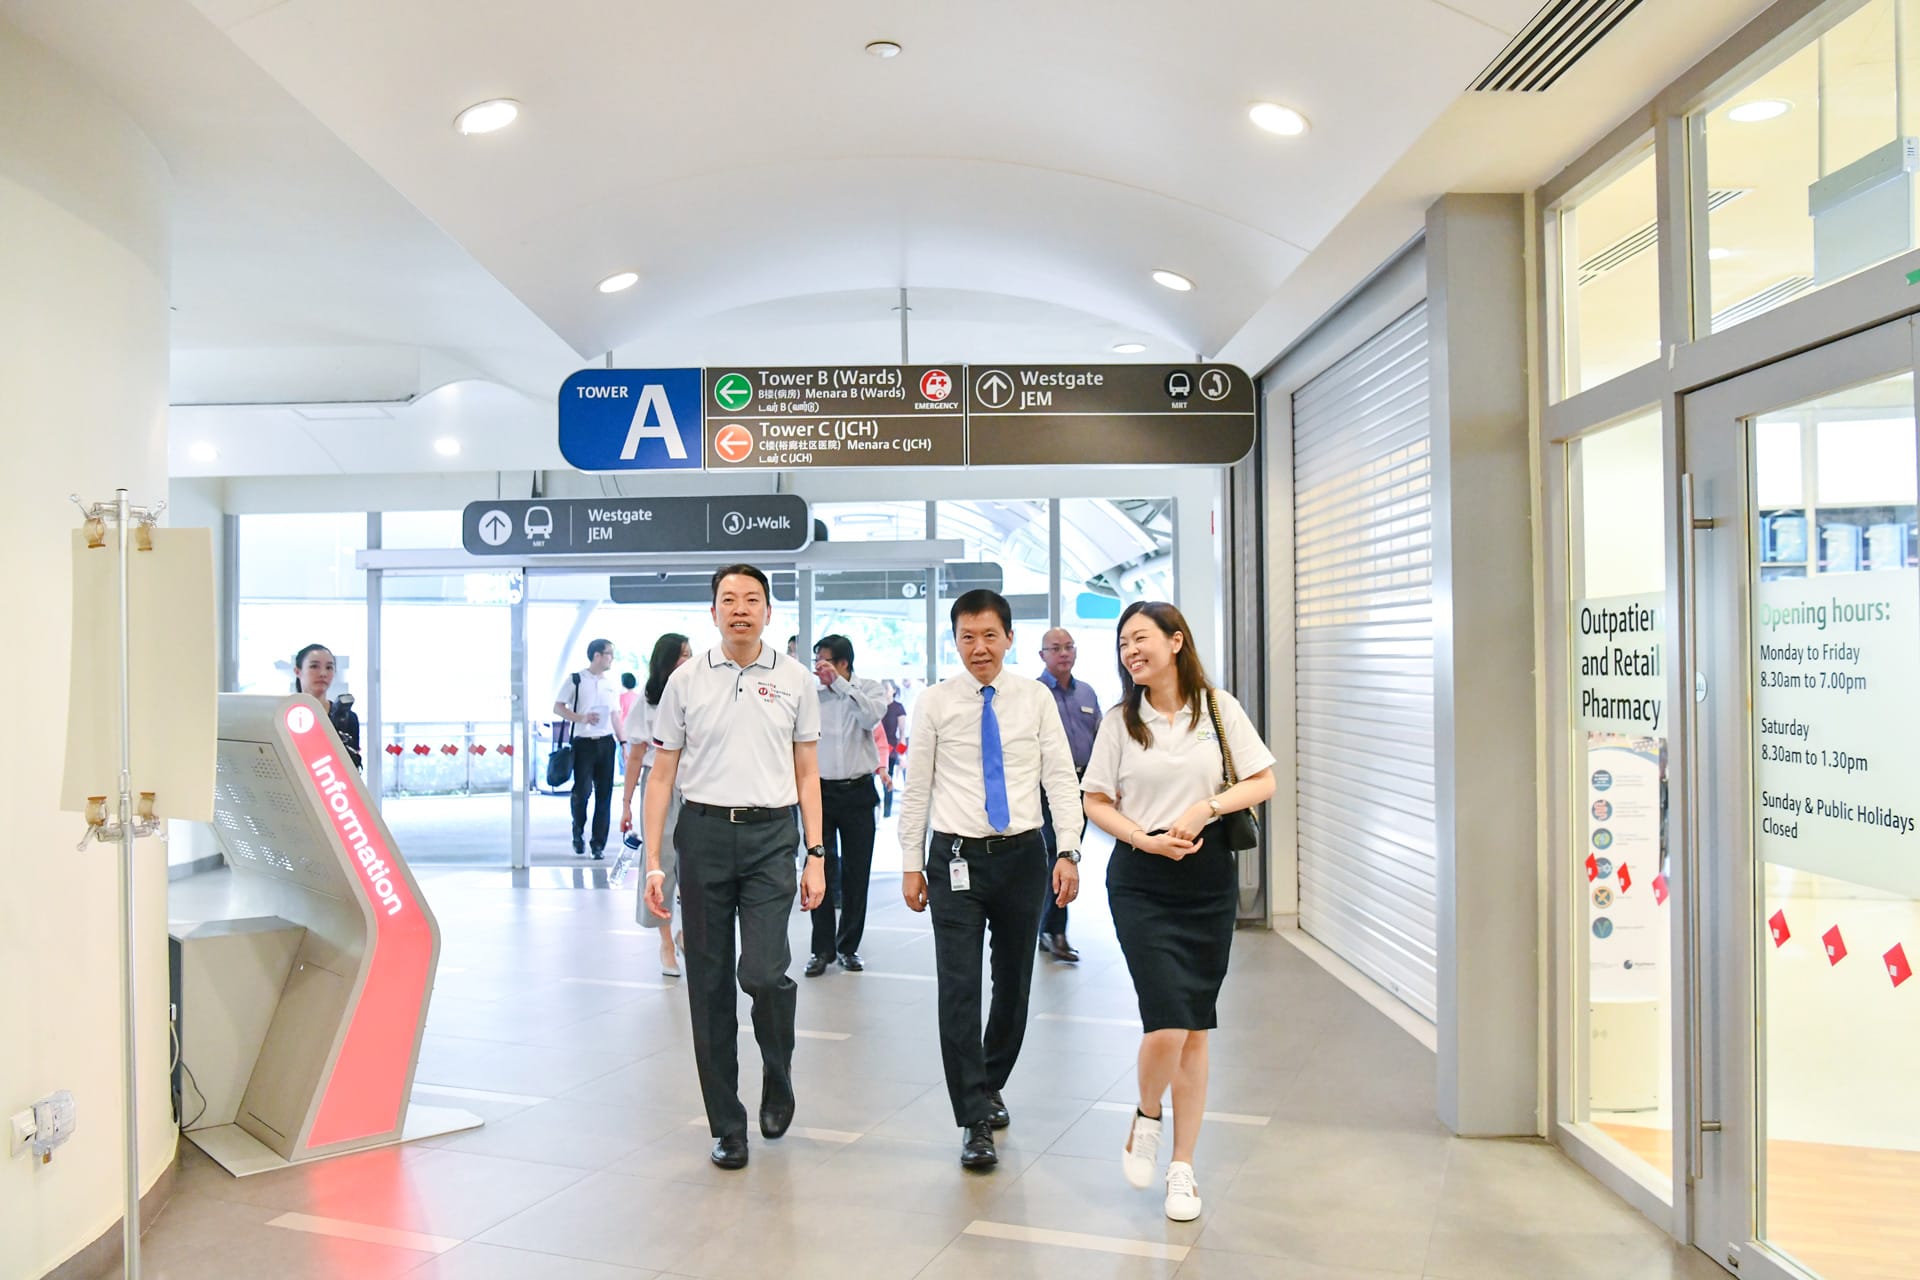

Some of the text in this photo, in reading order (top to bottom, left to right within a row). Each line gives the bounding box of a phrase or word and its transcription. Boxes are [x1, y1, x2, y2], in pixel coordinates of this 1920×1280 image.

[758, 369, 902, 388] Tower B (Wards)
[1020, 371, 1104, 389] Westgate
[576, 386, 629, 399] TOWER
[805, 387, 906, 400] Menara B (Wards)
[1019, 391, 1052, 410] JEM
[780, 402, 787, 412] B
[914, 402, 959, 410] EMERGENCY
[619, 384, 688, 460] A
[759, 420, 879, 440] Tower C (JCH)
[847, 438, 932, 452] Menara C (JCH)
[780, 454, 787, 462] C
[789, 453, 813, 463] (JCH)
[588, 509, 652, 524] Westgate
[746, 515, 791, 530] J-Walk
[587, 527, 613, 543] JEM
[1581, 602, 1655, 642] Outpatie
[1760, 597, 1890, 632] Opening hours:
[1582, 643, 1660, 677] and Retail
[1760, 642, 1860, 665] Monday to Friday
[1760, 671, 1867, 694] 8.30am to 7.00pm
[1582, 688, 1661, 731] Pharmacy
[1761, 717, 1809, 742] Saturday
[1761, 744, 1868, 775] 8.30am to 1.30pm
[1762, 791, 1915, 835] Sunday & Public Holidays
[311, 754, 403, 916] Information
[1762, 817, 1798, 839] Closed
